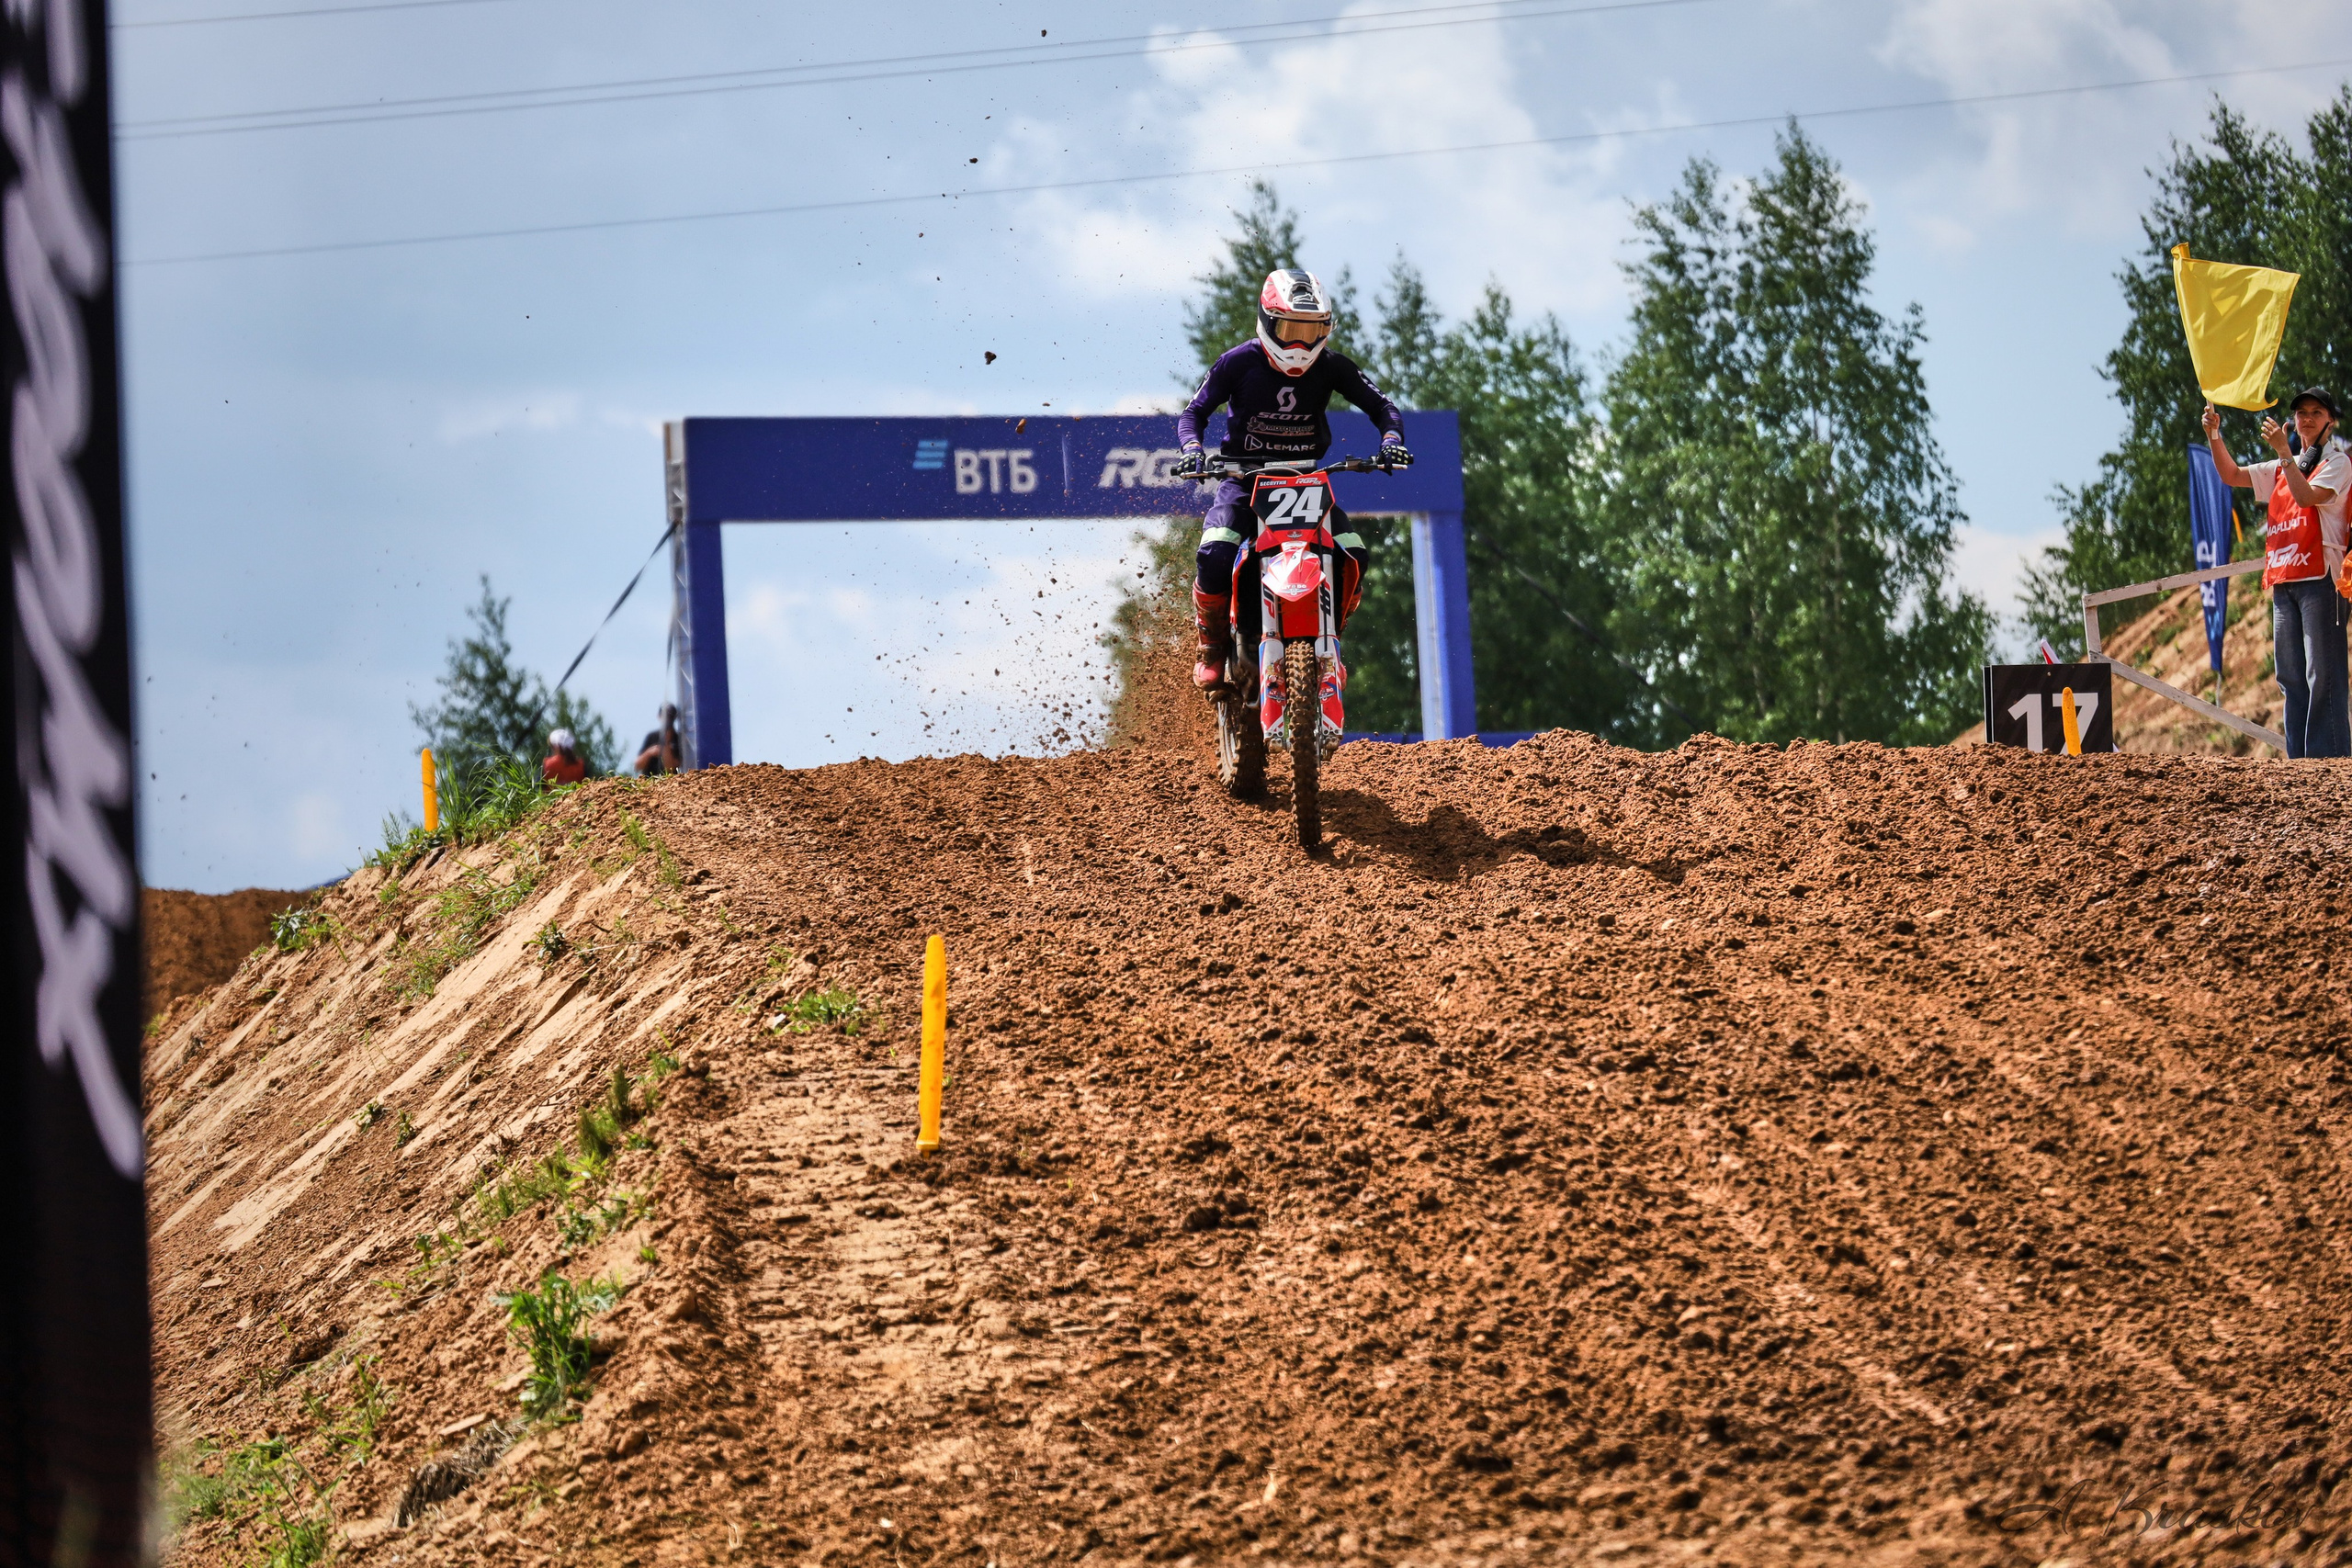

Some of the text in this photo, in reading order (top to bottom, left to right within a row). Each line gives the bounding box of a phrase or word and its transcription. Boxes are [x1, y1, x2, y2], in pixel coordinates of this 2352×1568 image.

[1257, 412, 1312, 421] SCOTT
[954, 448, 1037, 493] ВТБ
[1264, 487, 1324, 525] 24
[2007, 692, 2099, 755] 17
